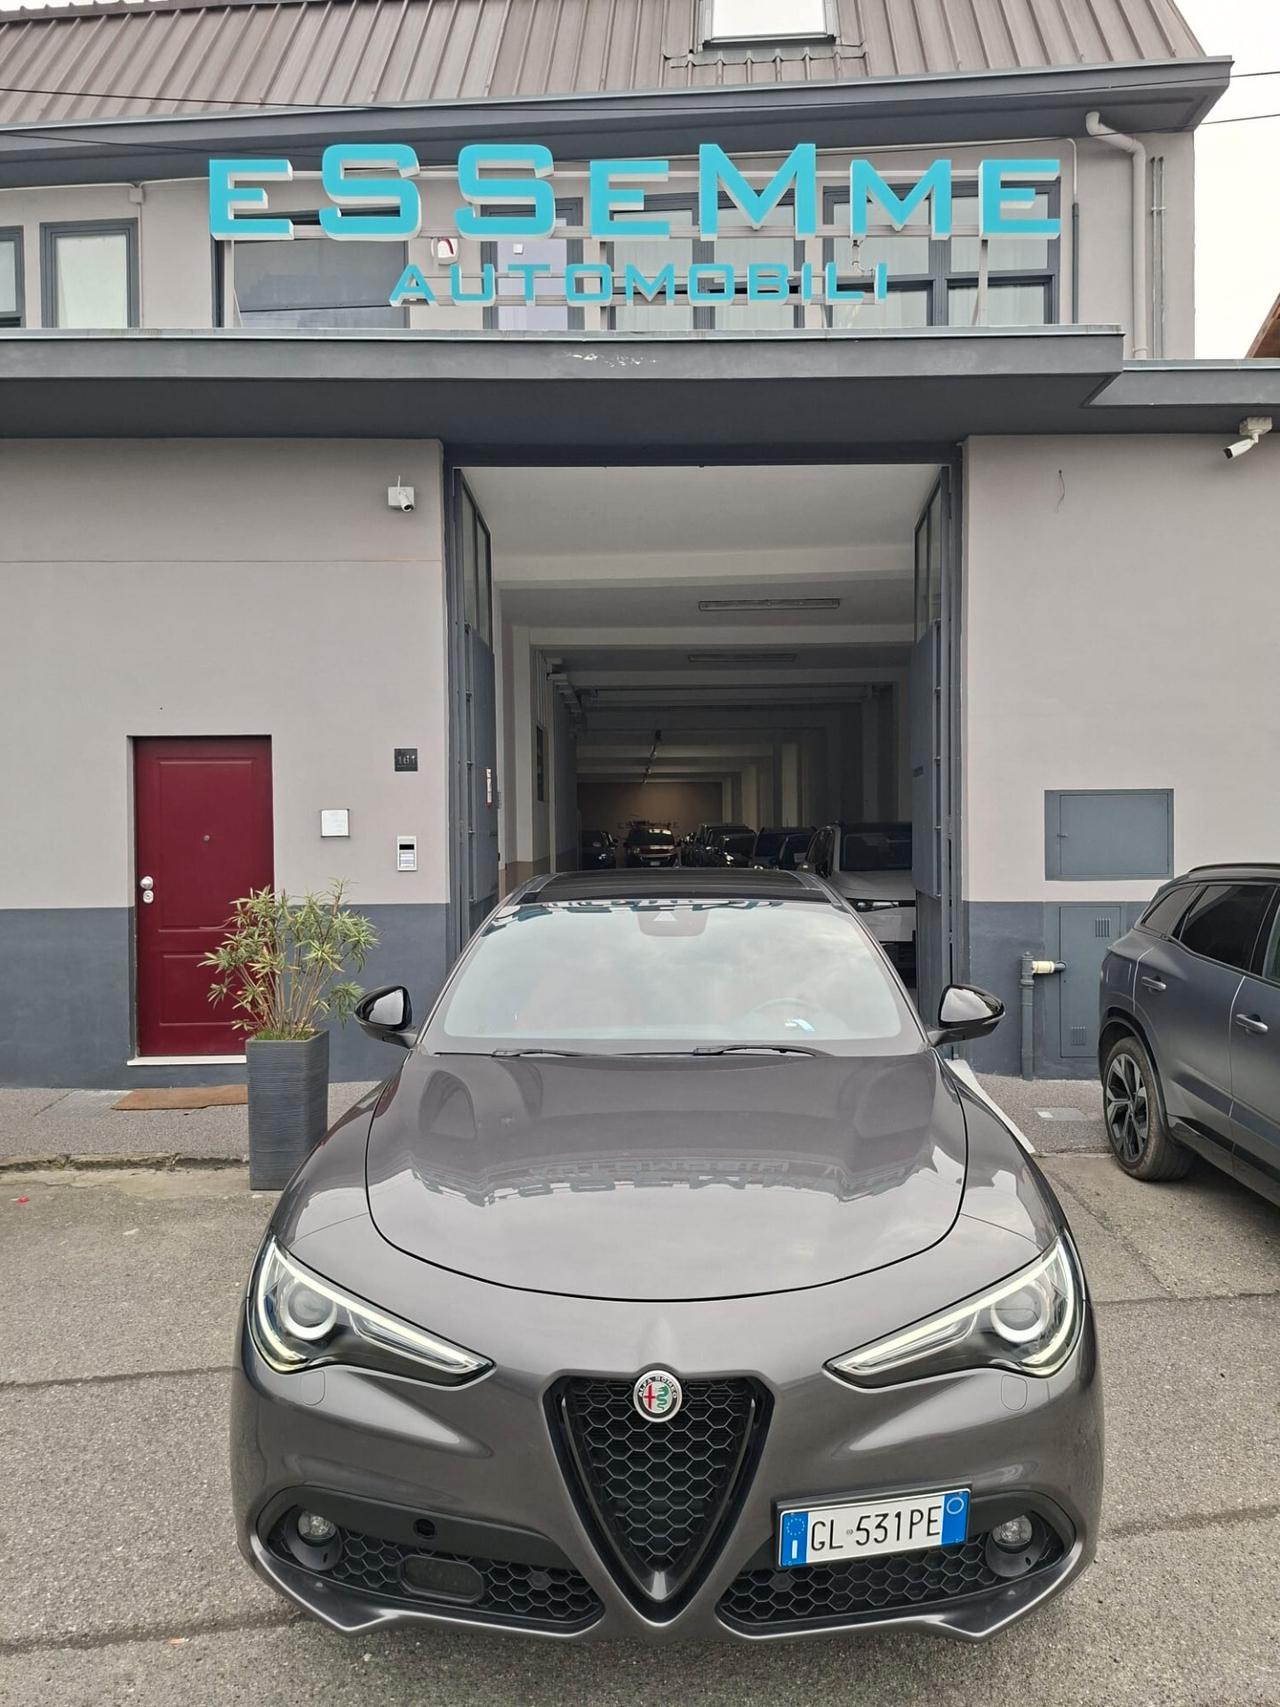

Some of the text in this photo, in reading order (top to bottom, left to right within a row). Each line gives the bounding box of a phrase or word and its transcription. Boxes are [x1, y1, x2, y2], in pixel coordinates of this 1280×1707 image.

[208, 143, 1061, 240] ESSEMME
[389, 262, 888, 306] AUTOMOBILI
[810, 1506, 941, 1551] GL 531PE
